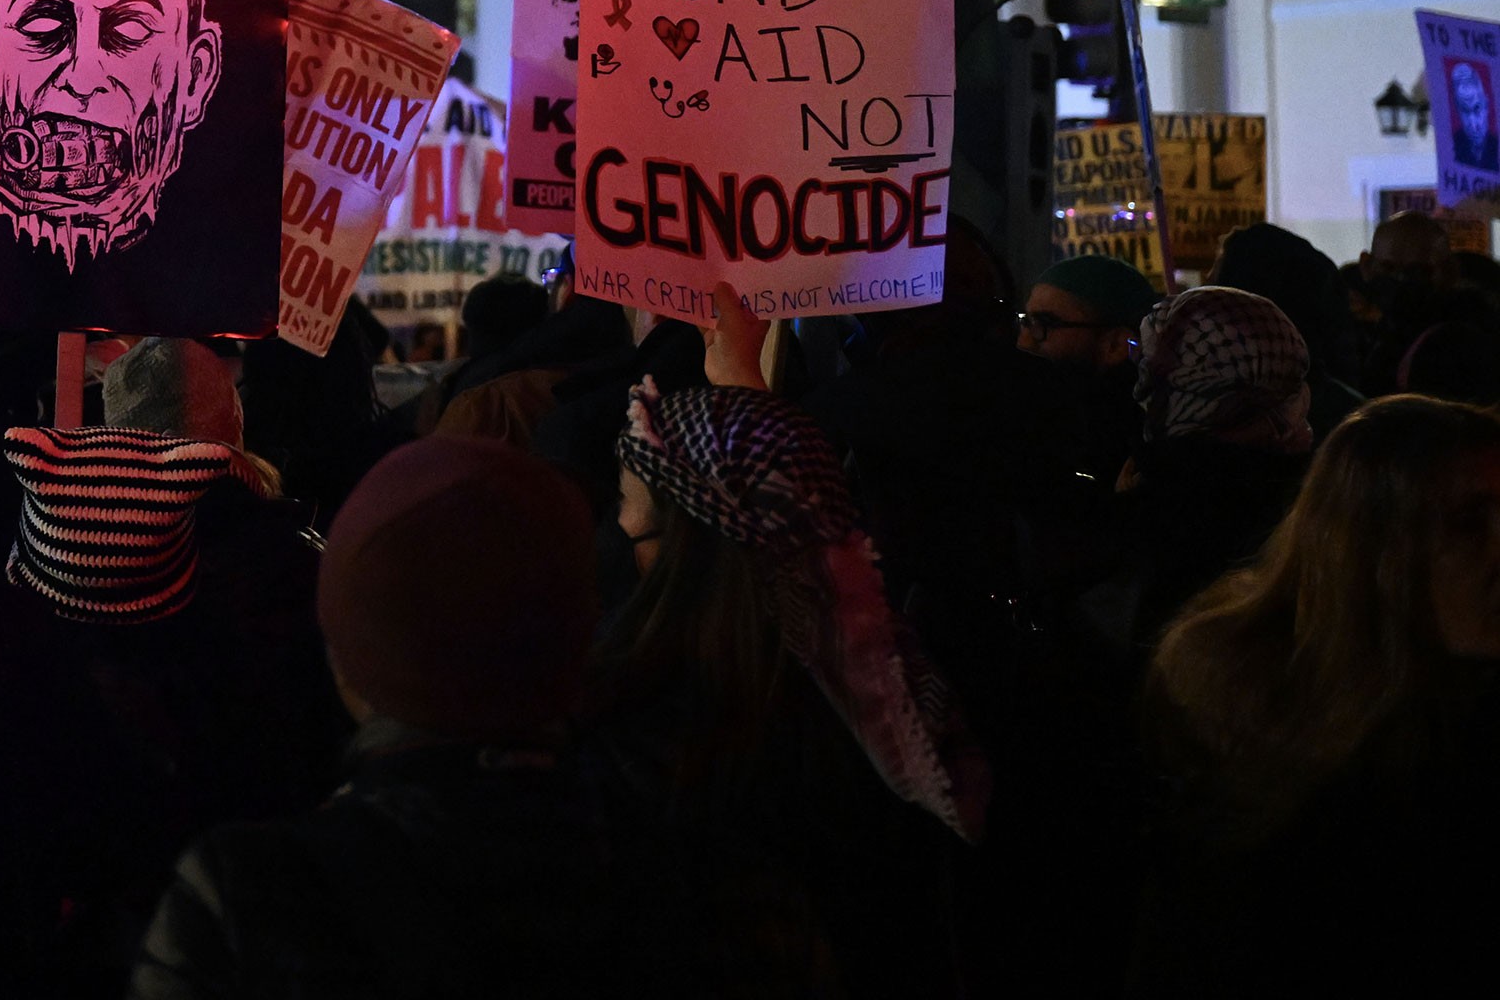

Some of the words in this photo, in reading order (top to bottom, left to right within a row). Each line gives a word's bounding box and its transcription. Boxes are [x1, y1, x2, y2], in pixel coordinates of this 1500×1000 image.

[714, 22, 866, 85] AID
[1426, 21, 1451, 47] TO
[1458, 27, 1498, 57] THE
[324, 66, 424, 142] ONLY
[800, 94, 953, 151] NOT
[286, 104, 398, 191] UTION
[1056, 160, 1146, 185] EAPONS
[585, 146, 950, 261] GENOCIDE
[580, 266, 634, 301] WAR
[644, 278, 774, 321] CRIMIALS
[782, 286, 823, 310] NOT
